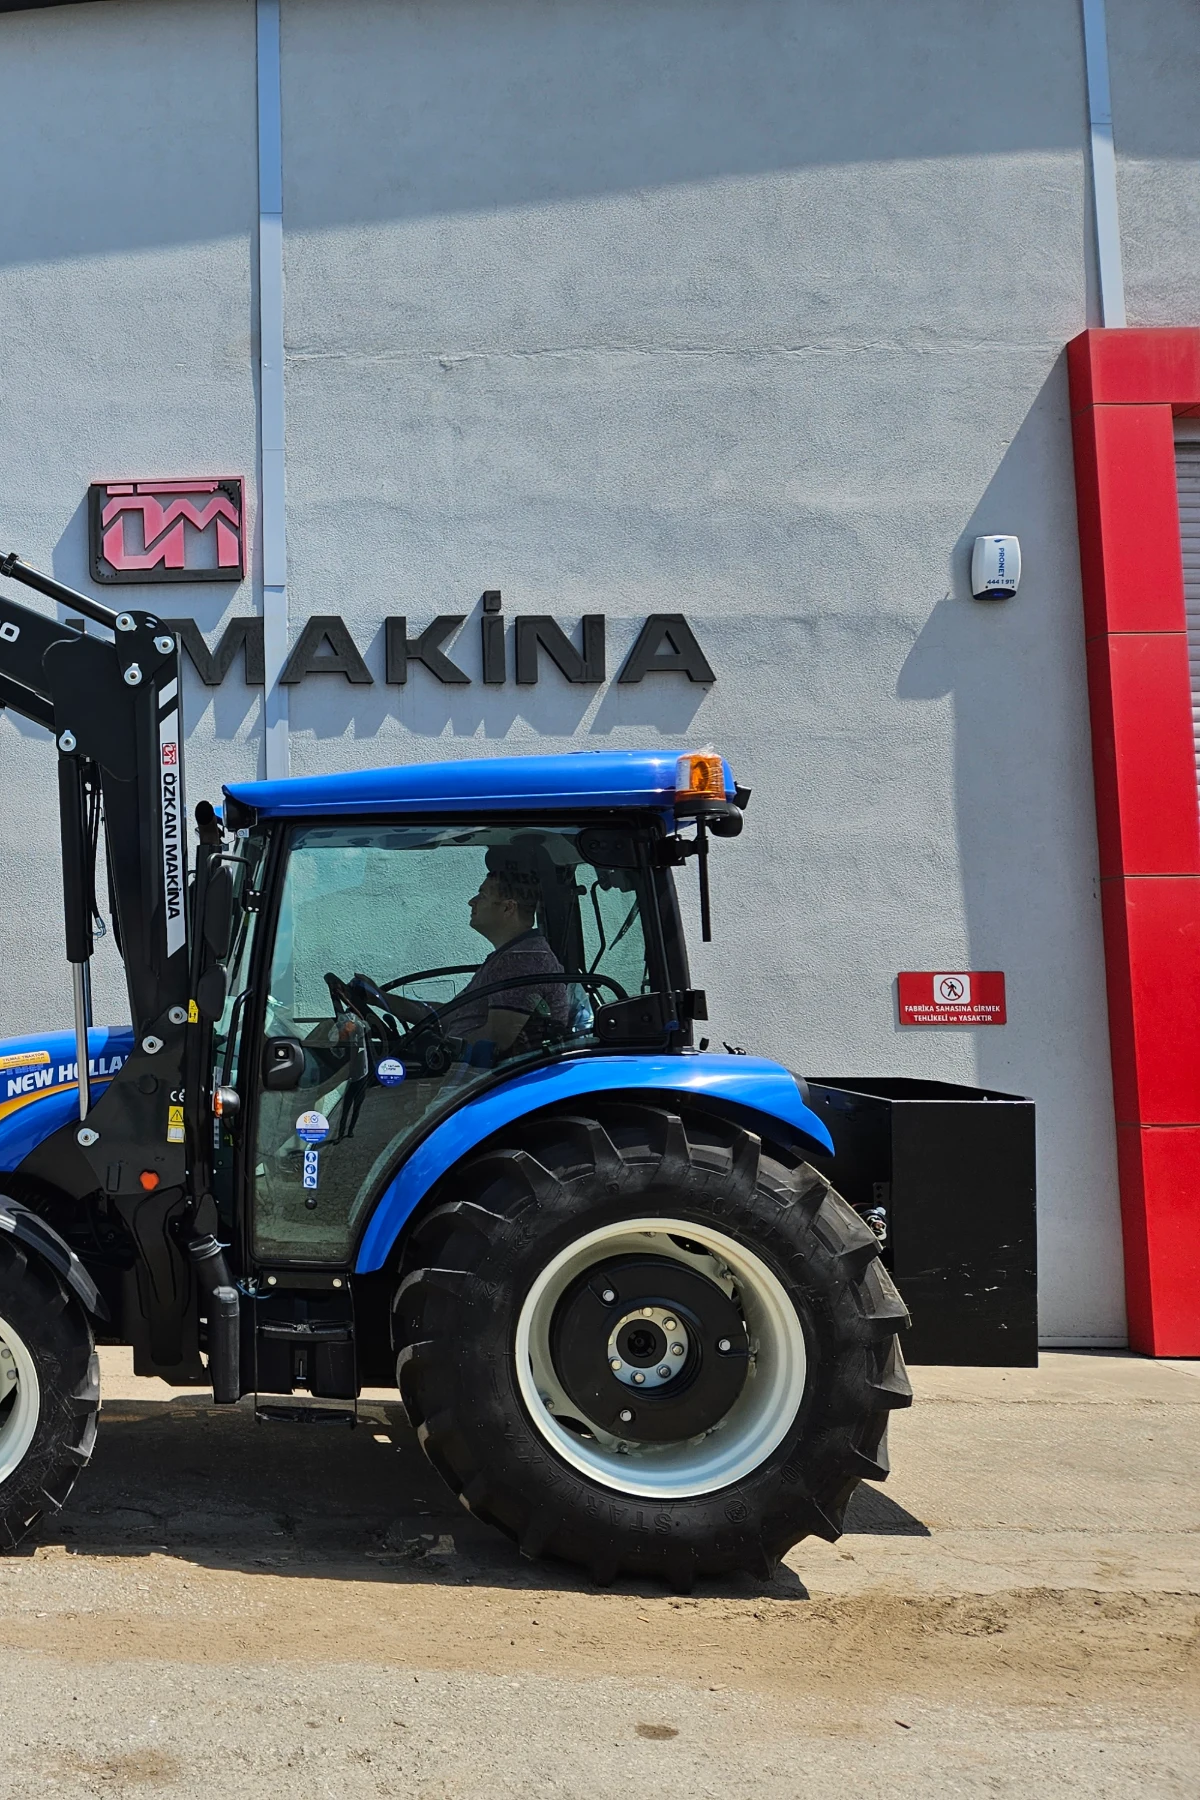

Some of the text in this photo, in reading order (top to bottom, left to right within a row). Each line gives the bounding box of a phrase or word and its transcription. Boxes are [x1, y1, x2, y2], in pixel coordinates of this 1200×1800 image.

[161, 589, 716, 685] MAKİNA
[163, 773, 181, 920] ÖZKAN MAKİNA
[905, 1004, 934, 1012] FABRİKA
[973, 1004, 1000, 1012] GİRMEK
[913, 1014, 948, 1022] TEHLİKELİ
[958, 1014, 992, 1022] YASAKTIR
[7, 1067, 54, 1097] NEW
[58, 1055, 129, 1082] HLLA
